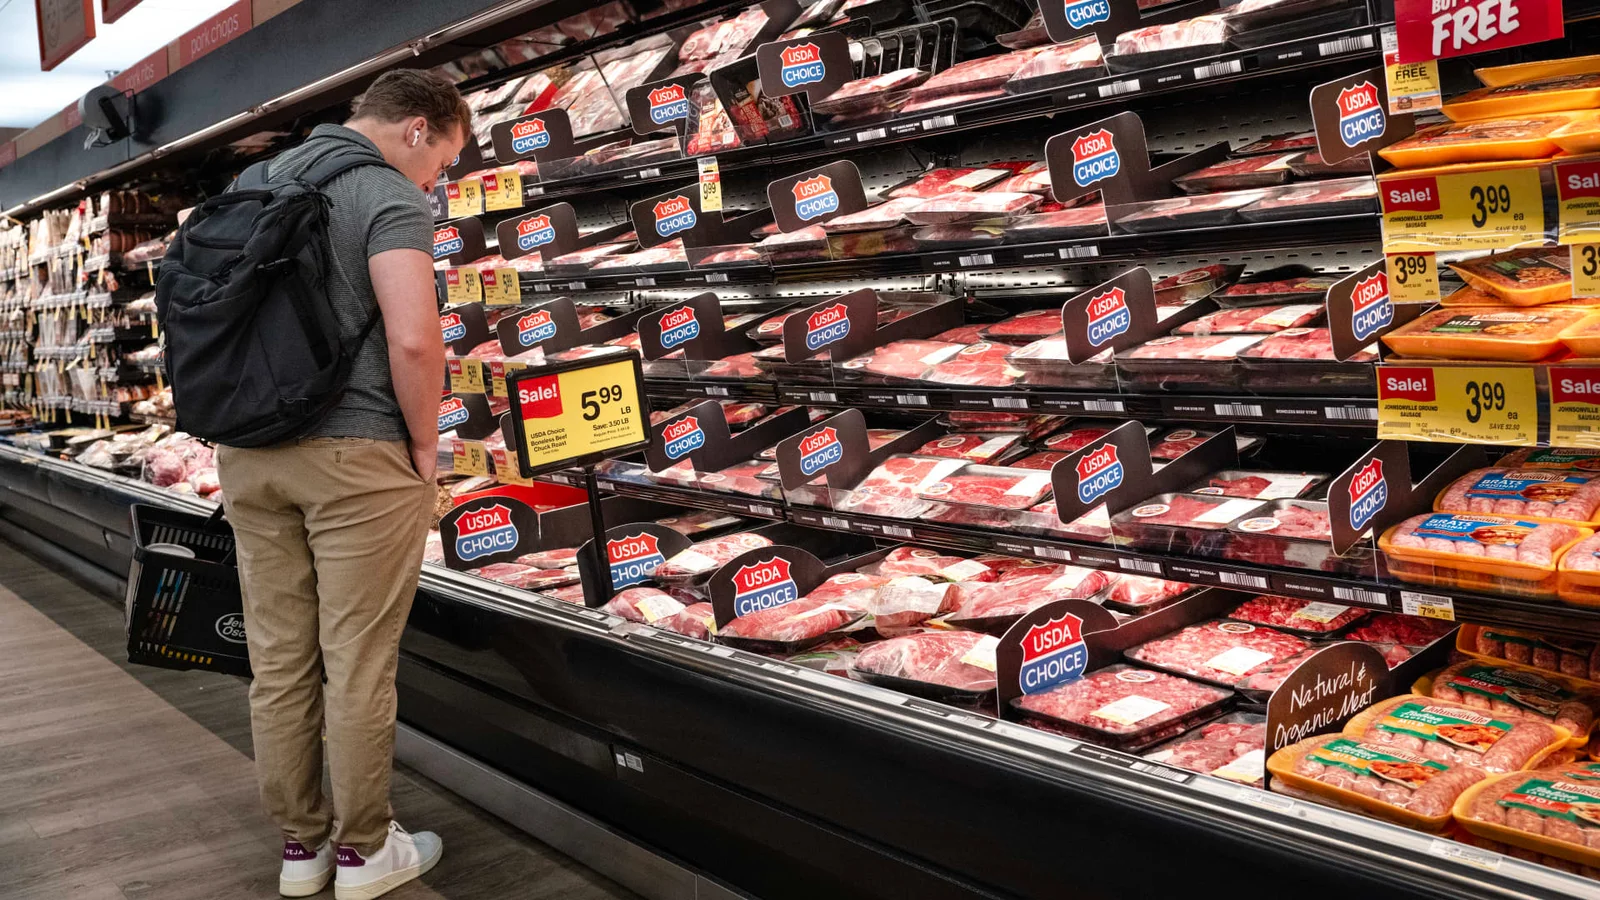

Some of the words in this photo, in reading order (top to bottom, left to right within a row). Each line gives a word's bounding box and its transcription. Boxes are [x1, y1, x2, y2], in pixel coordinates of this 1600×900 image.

[1069, 2, 1108, 23] CHOICE
[191, 28, 210, 57] pork
[210, 13, 239, 45] chops
[1431, 0, 1520, 56] FREE
[788, 48, 814, 63] USDA
[785, 65, 822, 82] CHOICE
[1395, 66, 1428, 80] FREE
[655, 88, 680, 103] USDA
[1345, 91, 1373, 111] USDA
[654, 102, 688, 119] CHOICE
[517, 123, 541, 136] USDA
[1344, 112, 1384, 136] CHOICE
[515, 134, 548, 150] CHOICE
[1079, 137, 1108, 156] USDA
[1077, 158, 1116, 181] CHOICE
[504, 178, 515, 199] 599
[800, 180, 826, 197] USDA
[1568, 173, 1600, 190] Sal
[465, 187, 475, 207] 599
[703, 182, 716, 200] 999
[1389, 187, 1431, 204] Sale!
[660, 201, 685, 216] USDA
[799, 195, 837, 215] CHOICE
[1470, 184, 1511, 228] 399
[1567, 202, 1600, 210] JOHNSONVIL
[1586, 208, 1600, 216] SAUS
[659, 214, 694, 232] CHOICE
[1389, 215, 1423, 223] JOHNSONVILLE
[1513, 212, 1524, 221] ea
[523, 220, 545, 233] USDA
[521, 230, 553, 247] CHOICE
[1395, 256, 1427, 285] 399
[465, 273, 475, 294] 599
[503, 273, 513, 294] 599
[1358, 280, 1383, 304] USDA
[1093, 294, 1120, 315] USDA
[440, 317, 456, 328] SDA
[523, 315, 546, 329] USDA
[665, 312, 690, 327] USDA
[814, 309, 841, 327] USDA
[1091, 312, 1128, 341] CHOICE
[1356, 303, 1392, 332] CHOICE
[522, 324, 553, 343] CHOICE
[664, 324, 697, 345] CHOICE
[810, 324, 847, 345] CHOICE
[1386, 377, 1428, 392] Sale!
[519, 383, 558, 405] Sale!
[581, 384, 623, 422] 599
[1465, 381, 1506, 423] 399
[620, 406, 632, 415] LB
[1507, 411, 1518, 420] ea
[1558, 406, 1599, 414] JOHNSONVILLE
[530, 431, 546, 439] USDA
[546, 427, 565, 436] Choice
[592, 422, 609, 431] Save:
[608, 420, 621, 428] 3.50
[621, 417, 629, 425] LB
[670, 421, 694, 439] USDA
[530, 437, 555, 447] Boneless
[555, 433, 568, 441] Beef
[533, 445, 551, 453] Chuck
[551, 441, 567, 449] Roast
[668, 434, 702, 455] CHOICE
[806, 433, 832, 452] USDA
[804, 447, 841, 471] CHOICE
[1084, 451, 1111, 473] USDA
[1082, 469, 1121, 496] CHOICE
[1356, 468, 1377, 495] USDA
[1509, 473, 1566, 482] Johnsonville
[1353, 485, 1385, 523] CHOICE
[466, 512, 501, 530] USDA
[1425, 523, 1467, 531] ORIGINAL
[1428, 518, 1472, 527] BRATS
[461, 530, 514, 553] CHOICE
[612, 540, 650, 559] USDA
[745, 566, 782, 587] USDA
[741, 587, 794, 614] CHOICE
[1420, 606, 1436, 616] 799
[222, 626, 247, 638] Osc
[1034, 625, 1073, 652] USDA
[1025, 651, 1083, 688] CHOICE
[1290, 660, 1355, 714] Natural
[1356, 662, 1367, 687] &
[1470, 679, 1495, 688] HOT
[1274, 707, 1334, 750] Organic
[1336, 679, 1377, 721] Meat
[1398, 718, 1425, 728] MILD
[1400, 714, 1438, 725] SAUSAGE
[1422, 705, 1489, 725] Johnsonville
[1359, 743, 1426, 764] Johnsonville
[1525, 794, 1556, 806] HOT
[1555, 783, 1600, 799] Johnso
[285, 848, 304, 856] VEJA
